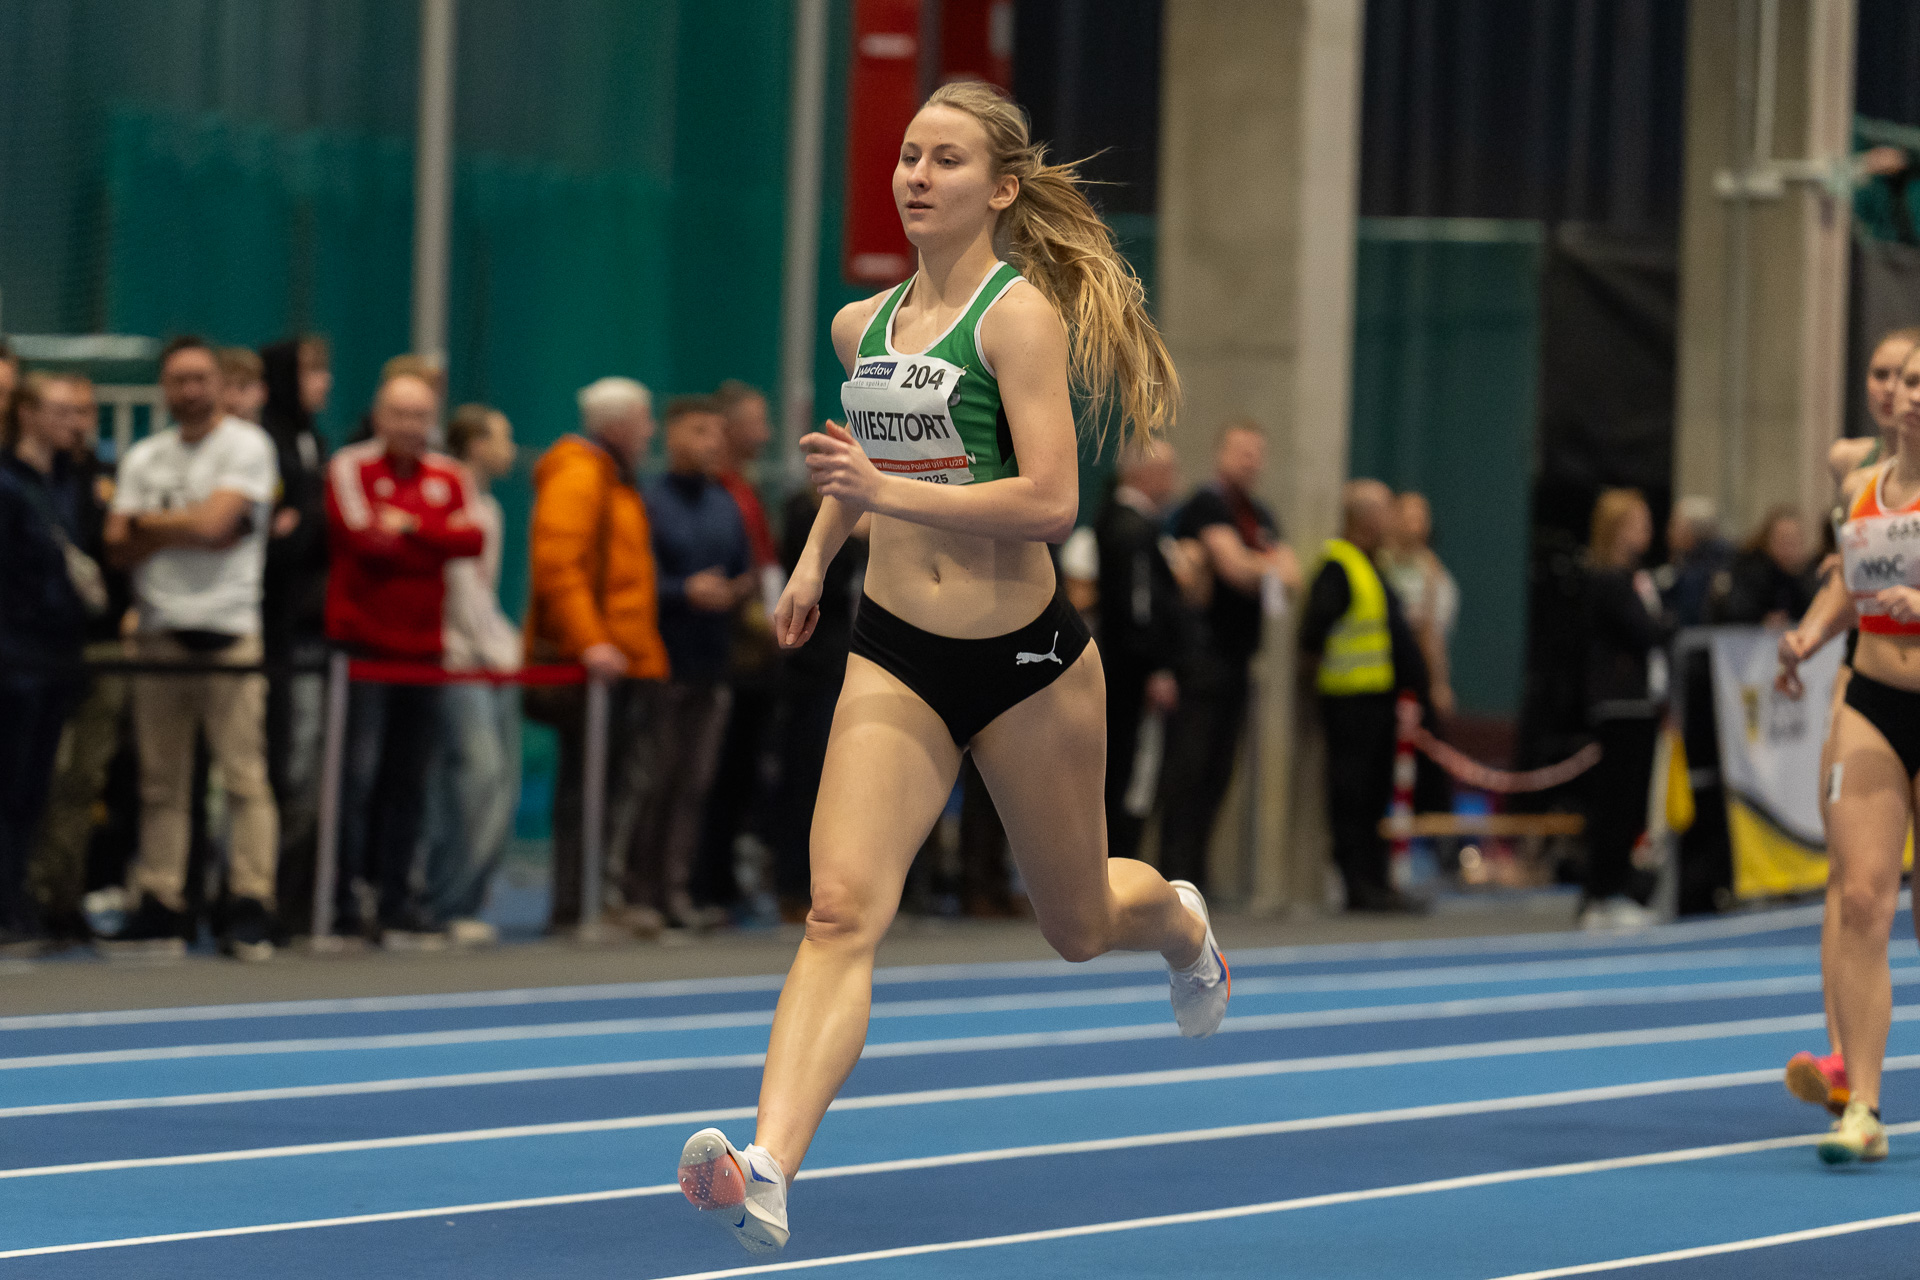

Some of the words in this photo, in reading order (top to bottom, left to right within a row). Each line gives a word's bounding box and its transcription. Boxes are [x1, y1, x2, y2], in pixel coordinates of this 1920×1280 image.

[900, 364, 946, 390] 204
[847, 409, 950, 442] WIESZTORT
[910, 462, 931, 471] Polski
[949, 458, 964, 467] U20
